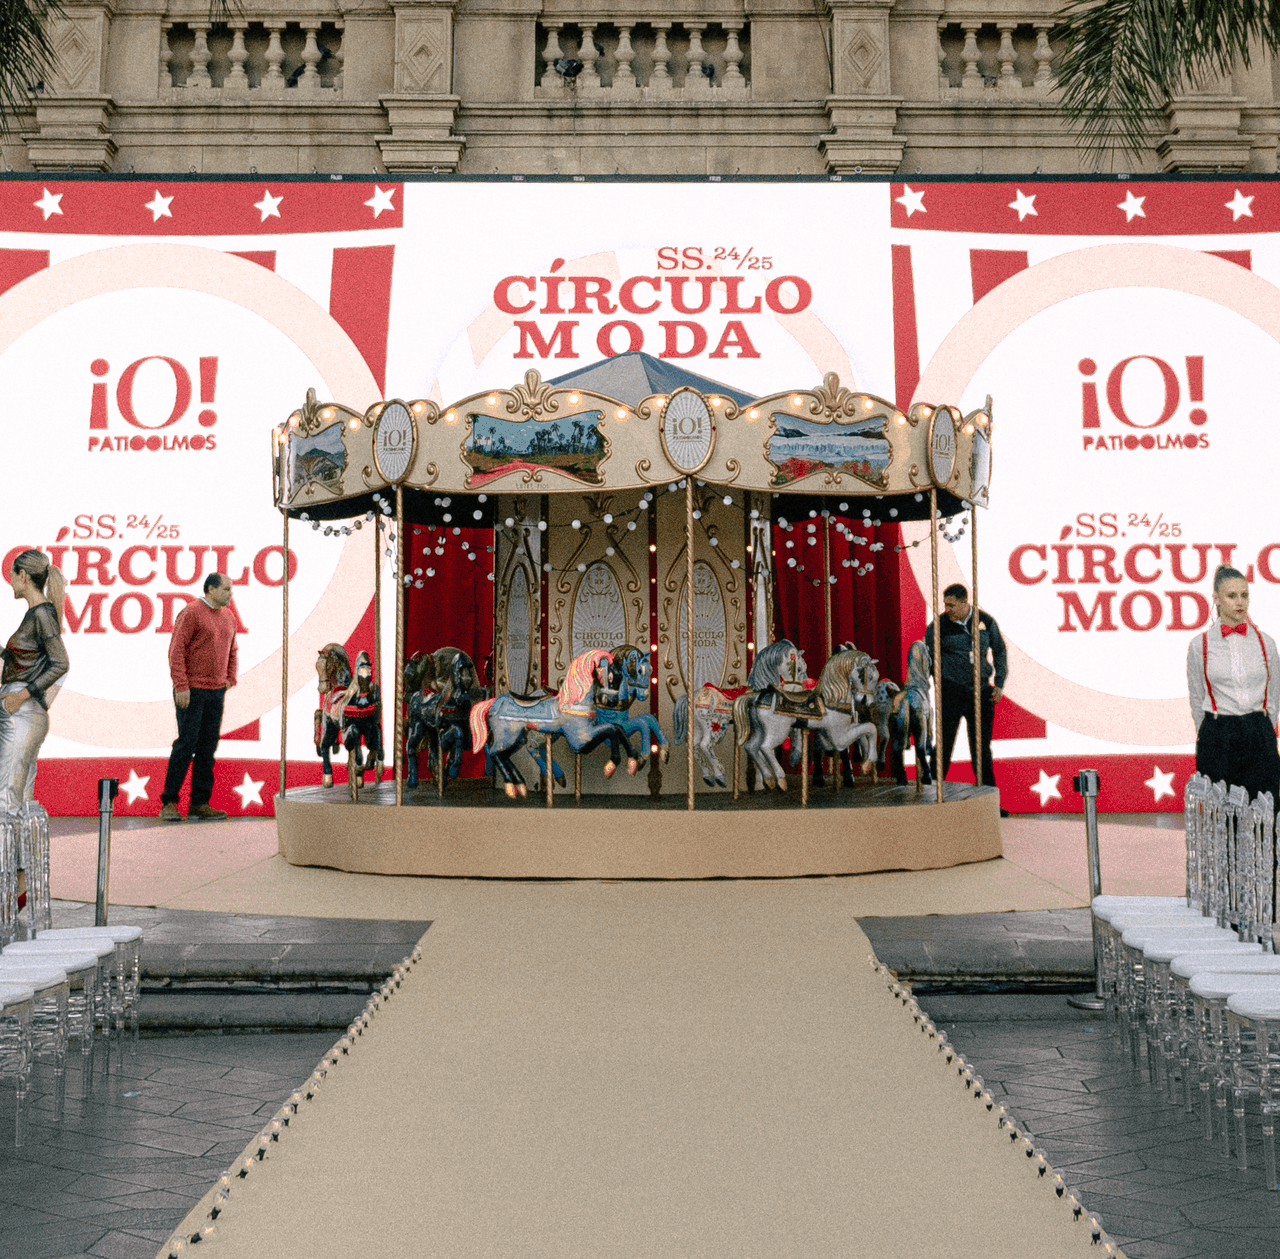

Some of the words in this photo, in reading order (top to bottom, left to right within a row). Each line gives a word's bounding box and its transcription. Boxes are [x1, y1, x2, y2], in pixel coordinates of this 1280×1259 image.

[493, 257, 813, 315] CÍRCULO
[513, 319, 762, 359] MODA
[88, 434, 217, 452] PATIOOLMOS
[1082, 432, 1210, 451] PATIOOLMOS
[1057, 590, 1210, 632] MOD
[681, 631, 724, 639] CRCULO
